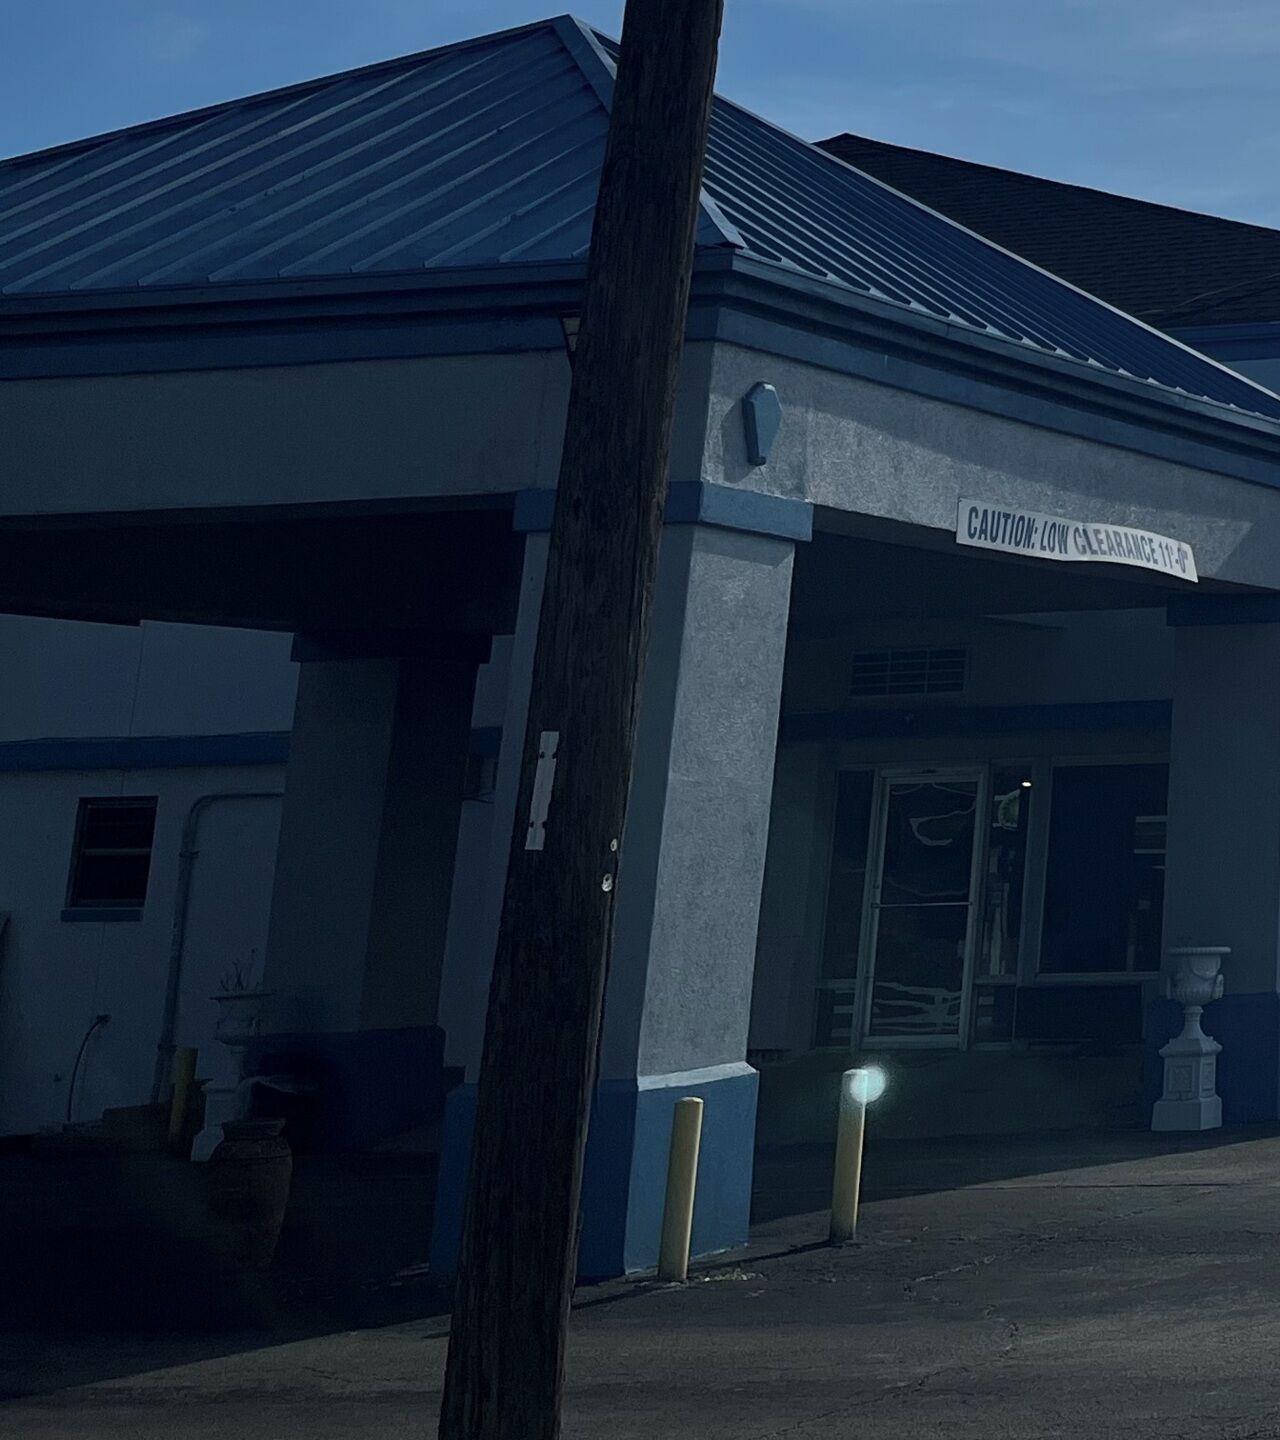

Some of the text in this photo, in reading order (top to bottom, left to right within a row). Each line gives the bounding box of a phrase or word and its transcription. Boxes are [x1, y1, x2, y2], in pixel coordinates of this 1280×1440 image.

[967, 505, 1038, 549] CAUTION:
[1039, 520, 1070, 555] LOW
[1072, 524, 1159, 565] CLEARANCE
